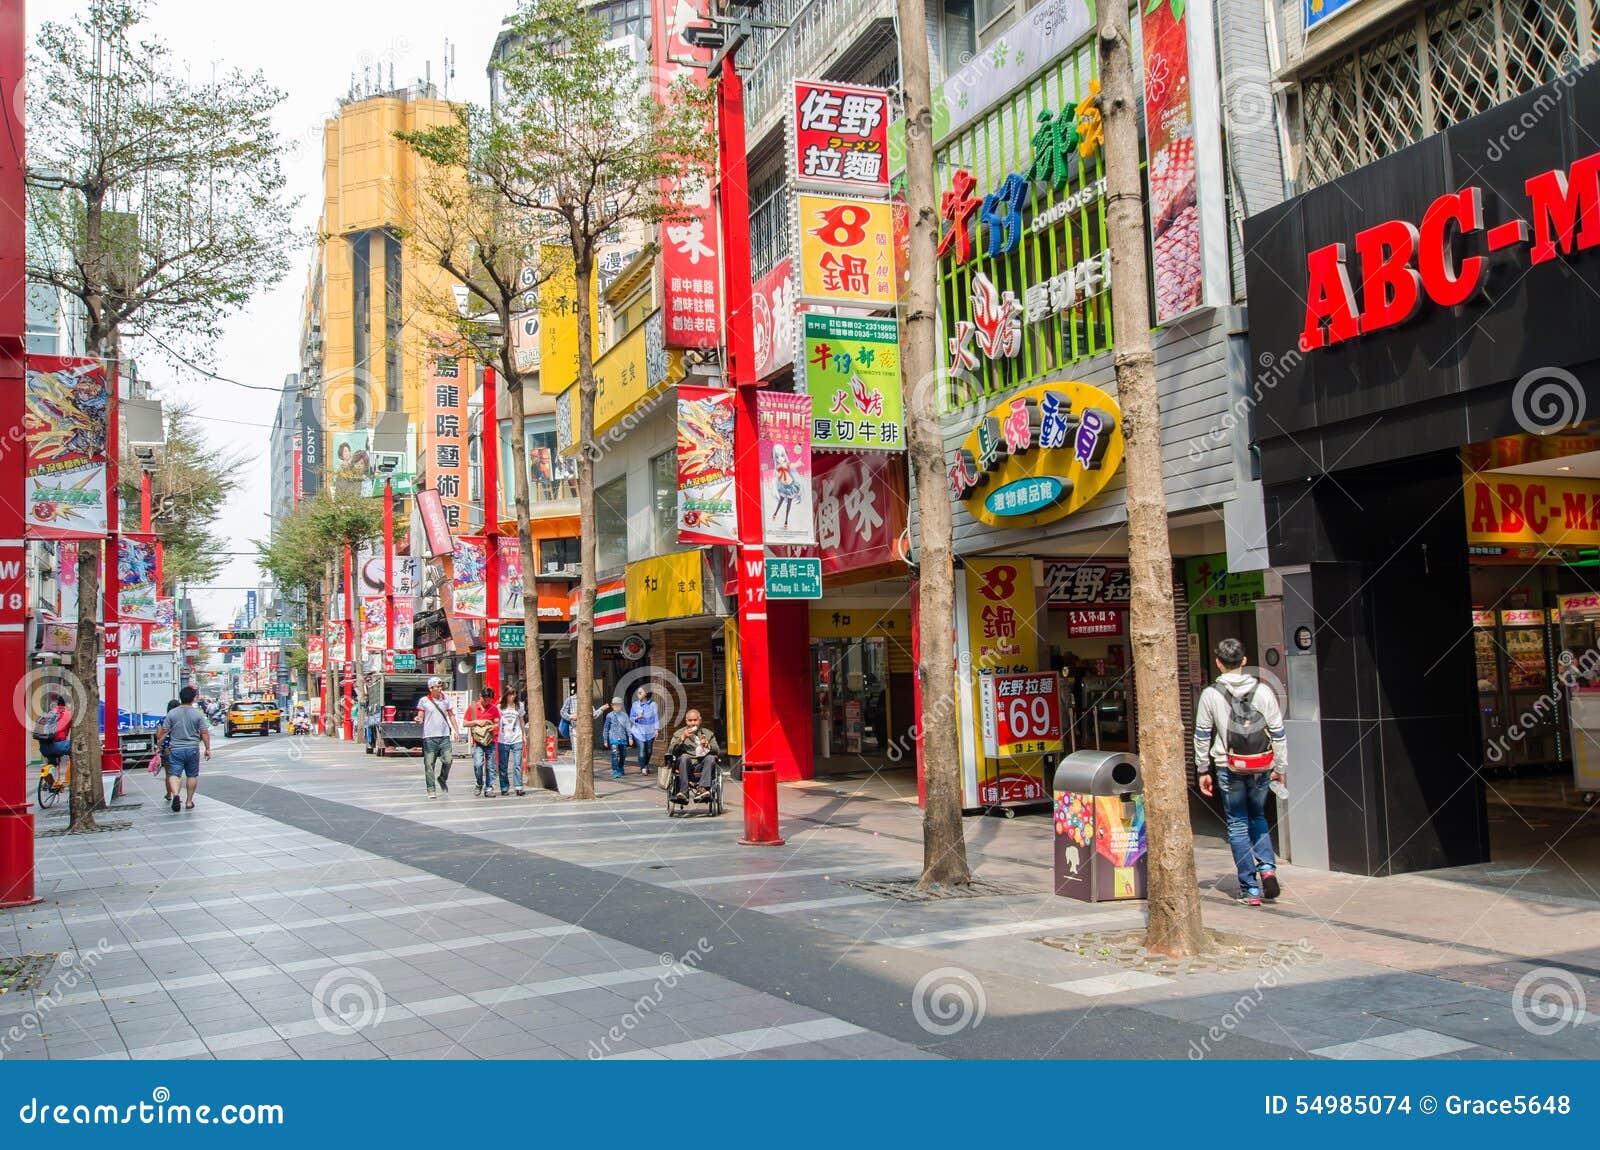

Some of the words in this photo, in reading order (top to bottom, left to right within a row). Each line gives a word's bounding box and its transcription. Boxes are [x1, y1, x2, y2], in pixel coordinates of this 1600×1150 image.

[800, 89, 883, 137] 佐野
[829, 137, 881, 152] ラーメン
[804, 145, 882, 182] 拉麵
[808, 205, 871, 247] 8
[819, 251, 870, 296] 鍋
[814, 418, 899, 443] 厚切牛排
[306, 425, 315, 464] SONY
[0, 560, 20, 579] W
[746, 561, 762, 577] W
[770, 563, 816, 578] 武昌街二段
[644, 575, 658, 593] 和
[975, 565, 1018, 601] 8
[1045, 564, 1106, 601] 佐野
[747, 588, 764, 602] 17
[488, 628, 498, 637] W
[981, 605, 1016, 639] 鍋
[105, 633, 117, 643] W
[105, 649, 117, 657] 20
[998, 678, 1054, 697] 佐野拉麵
[1009, 696, 1050, 738] 69
